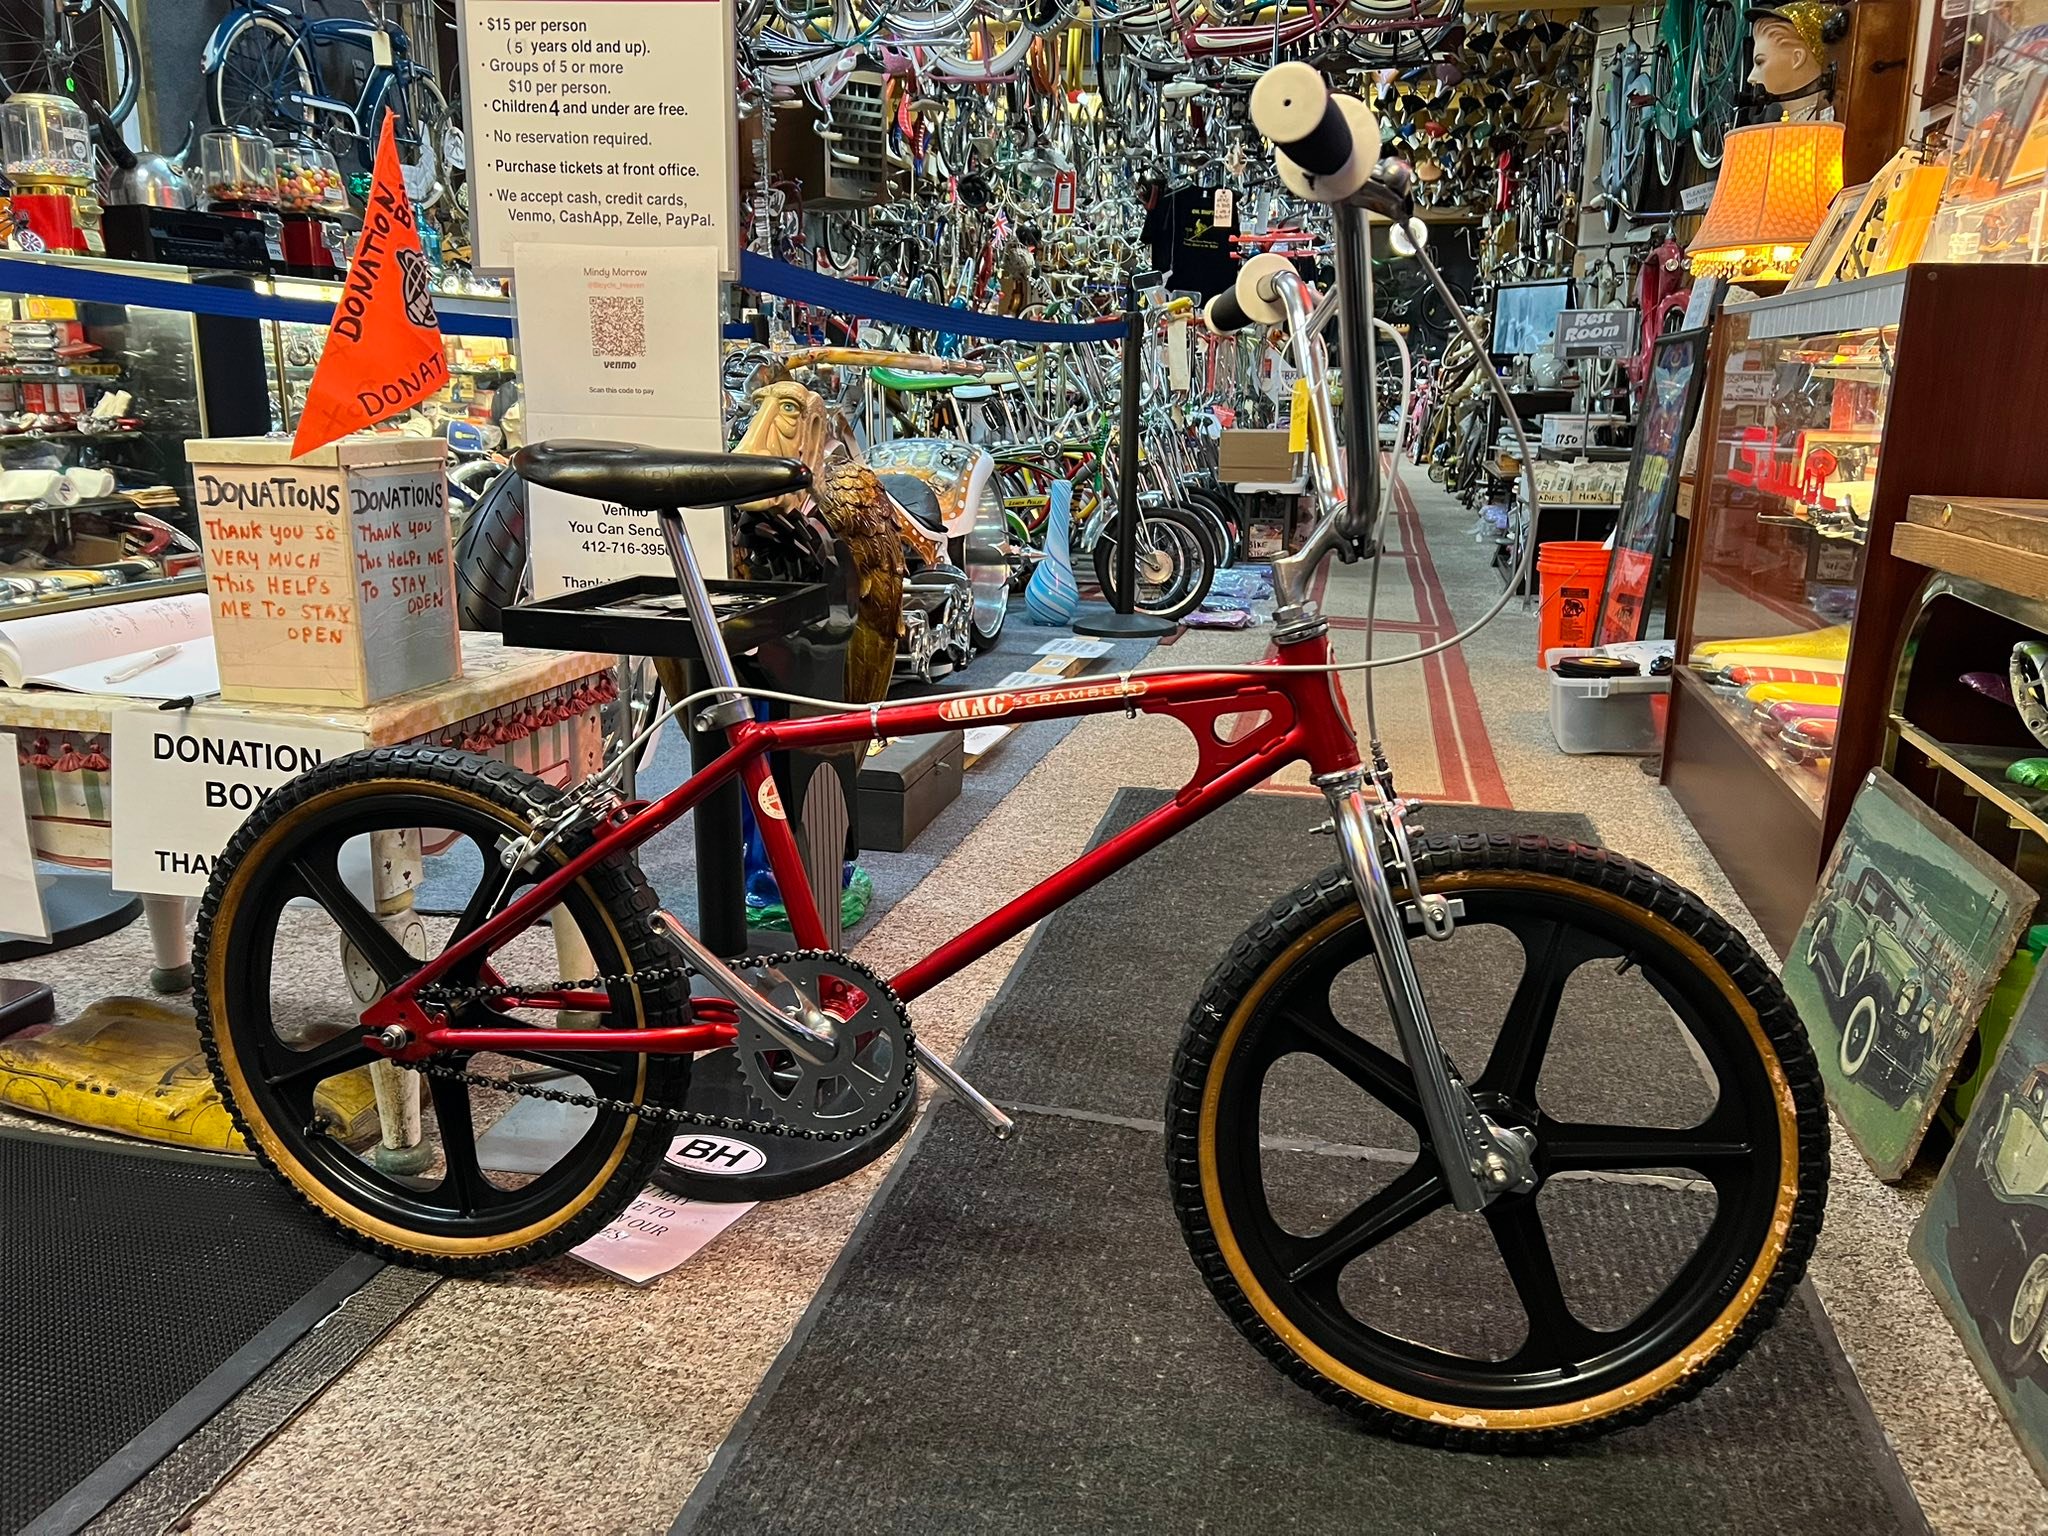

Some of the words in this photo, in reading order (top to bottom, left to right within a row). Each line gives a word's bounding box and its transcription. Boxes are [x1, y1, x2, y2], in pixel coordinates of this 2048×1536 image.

[487, 18, 511, 32] $15
[515, 20, 536, 35] per
[540, 20, 587, 35] person
[531, 41, 567, 56] years
[571, 40, 592, 53] old
[596, 40, 620, 53] and
[624, 40, 651, 56] up).
[489, 59, 539, 75] Groups
[543, 61, 556, 73] of
[559, 61, 568, 73] 5
[571, 63, 585, 74] or
[589, 63, 624, 74] more
[508, 79, 532, 94] $10
[536, 82, 557, 96] per
[561, 82, 611, 96] person.
[491, 100, 547, 114] Children
[549, 100, 560, 117] 4
[562, 101, 587, 115] and
[591, 102, 630, 116] under
[633, 104, 655, 116] are
[658, 102, 688, 116] free.
[494, 130, 512, 143] No
[515, 131, 589, 145] reservation
[593, 131, 652, 148] required.
[495, 159, 556, 174] Purchase
[560, 161, 603, 176] tickets
[607, 163, 620, 176] at
[623, 162, 655, 177] front
[658, 162, 699, 178] office.
[497, 189, 517, 202] We
[520, 191, 563, 206] accept
[567, 191, 602, 206] cash,
[605, 191, 642, 206] credit
[646, 192, 688, 208] cards,
[508, 209, 556, 225] Venmo,
[559, 210, 623, 227] CashApp,
[626, 211, 662, 227] Zelle,
[666, 213, 715, 229] PayPal.
[583, 268, 610, 279] Mindy
[612, 268, 648, 277] Morrow
[1574, 313, 1614, 327] Rest
[603, 360, 637, 370] venmo
[589, 387, 604, 395] Scan
[606, 387, 618, 395] this
[618, 387, 634, 395] code
[643, 388, 655, 397] pay
[568, 521, 593, 534] You
[597, 522, 624, 535] Can
[268, 552, 320, 568] MUCH
[428, 548, 444, 566] ME
[220, 601, 251, 619] ME
[300, 604, 350, 624] STAY
[288, 627, 342, 644] OPEN
[948, 695, 1006, 719] MAG
[1012, 685, 1138, 706] SCRAMBLER
[154, 733, 322, 773] DONATION
[676, 1139, 750, 1167] BH
[649, 1205, 676, 1219] TO
[627, 1219, 669, 1236] OUR
